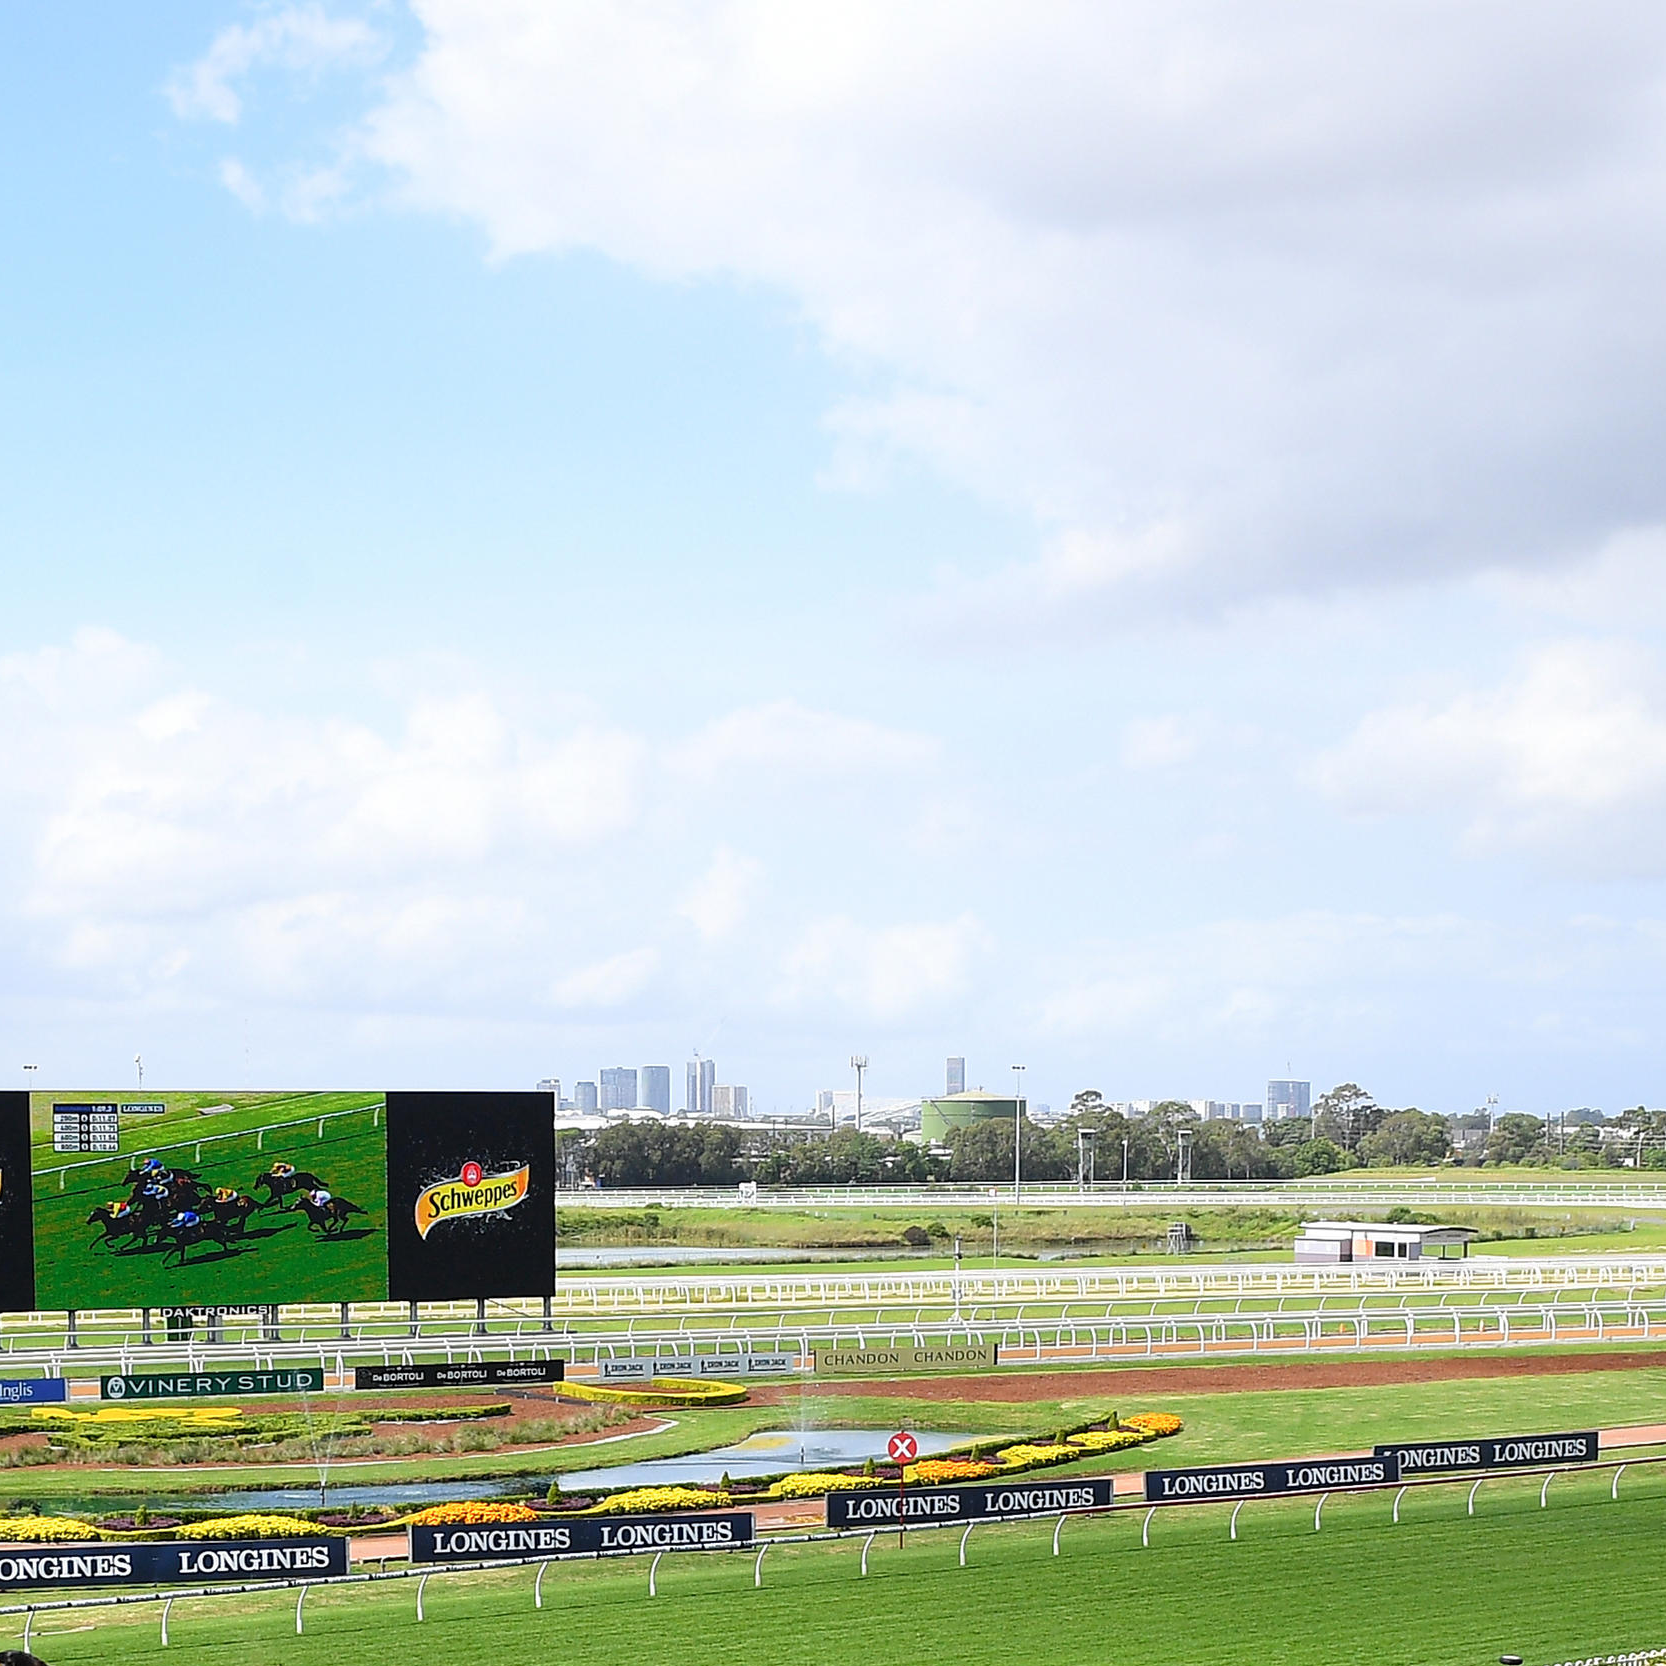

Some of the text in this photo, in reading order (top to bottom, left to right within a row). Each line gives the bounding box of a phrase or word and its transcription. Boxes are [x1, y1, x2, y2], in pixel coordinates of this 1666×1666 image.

[428, 1180, 517, 1218] Schweppes
[163, 1304, 268, 1318] DAKTRONICS
[825, 1349, 986, 1366] CHANDON CHANDON
[0, 1382, 33, 1401] Inglis
[128, 1372, 313, 1395] VINERY STUD
[1383, 1440, 1588, 1469] ONGINES LONGINES
[1163, 1463, 1386, 1495] LONGINES LONGINES
[846, 1487, 1095, 1520] LONGINES LONGINES
[433, 1520, 733, 1555] LONGINES LONGINES
[179, 1546, 331, 1574] LONGINES
